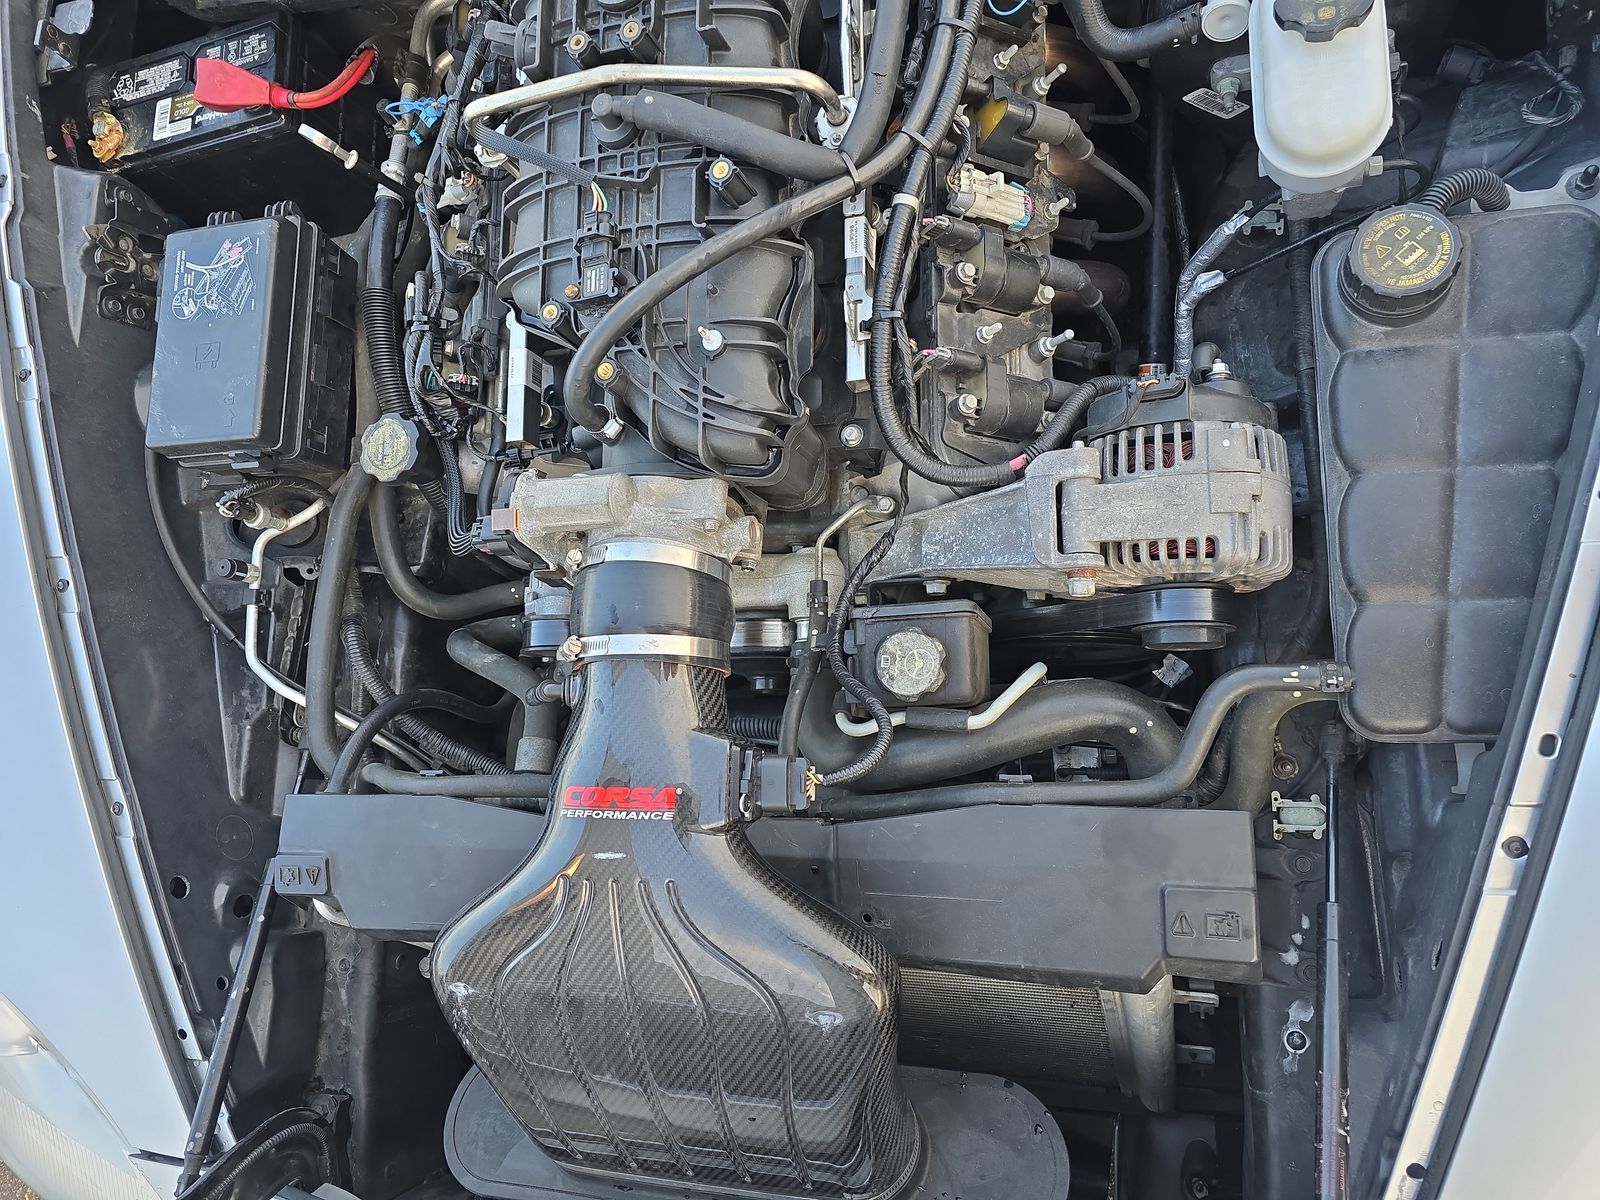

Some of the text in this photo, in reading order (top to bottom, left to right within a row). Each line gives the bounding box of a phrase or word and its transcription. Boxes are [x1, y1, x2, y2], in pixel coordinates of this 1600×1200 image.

[174, 108, 189, 116] GOLD
[1395, 275, 1424, 286] JAMAIS
[1424, 258, 1447, 280] OUVRIR
[563, 786, 676, 810] CORSA
[560, 809, 675, 820] PERFORMANCE
